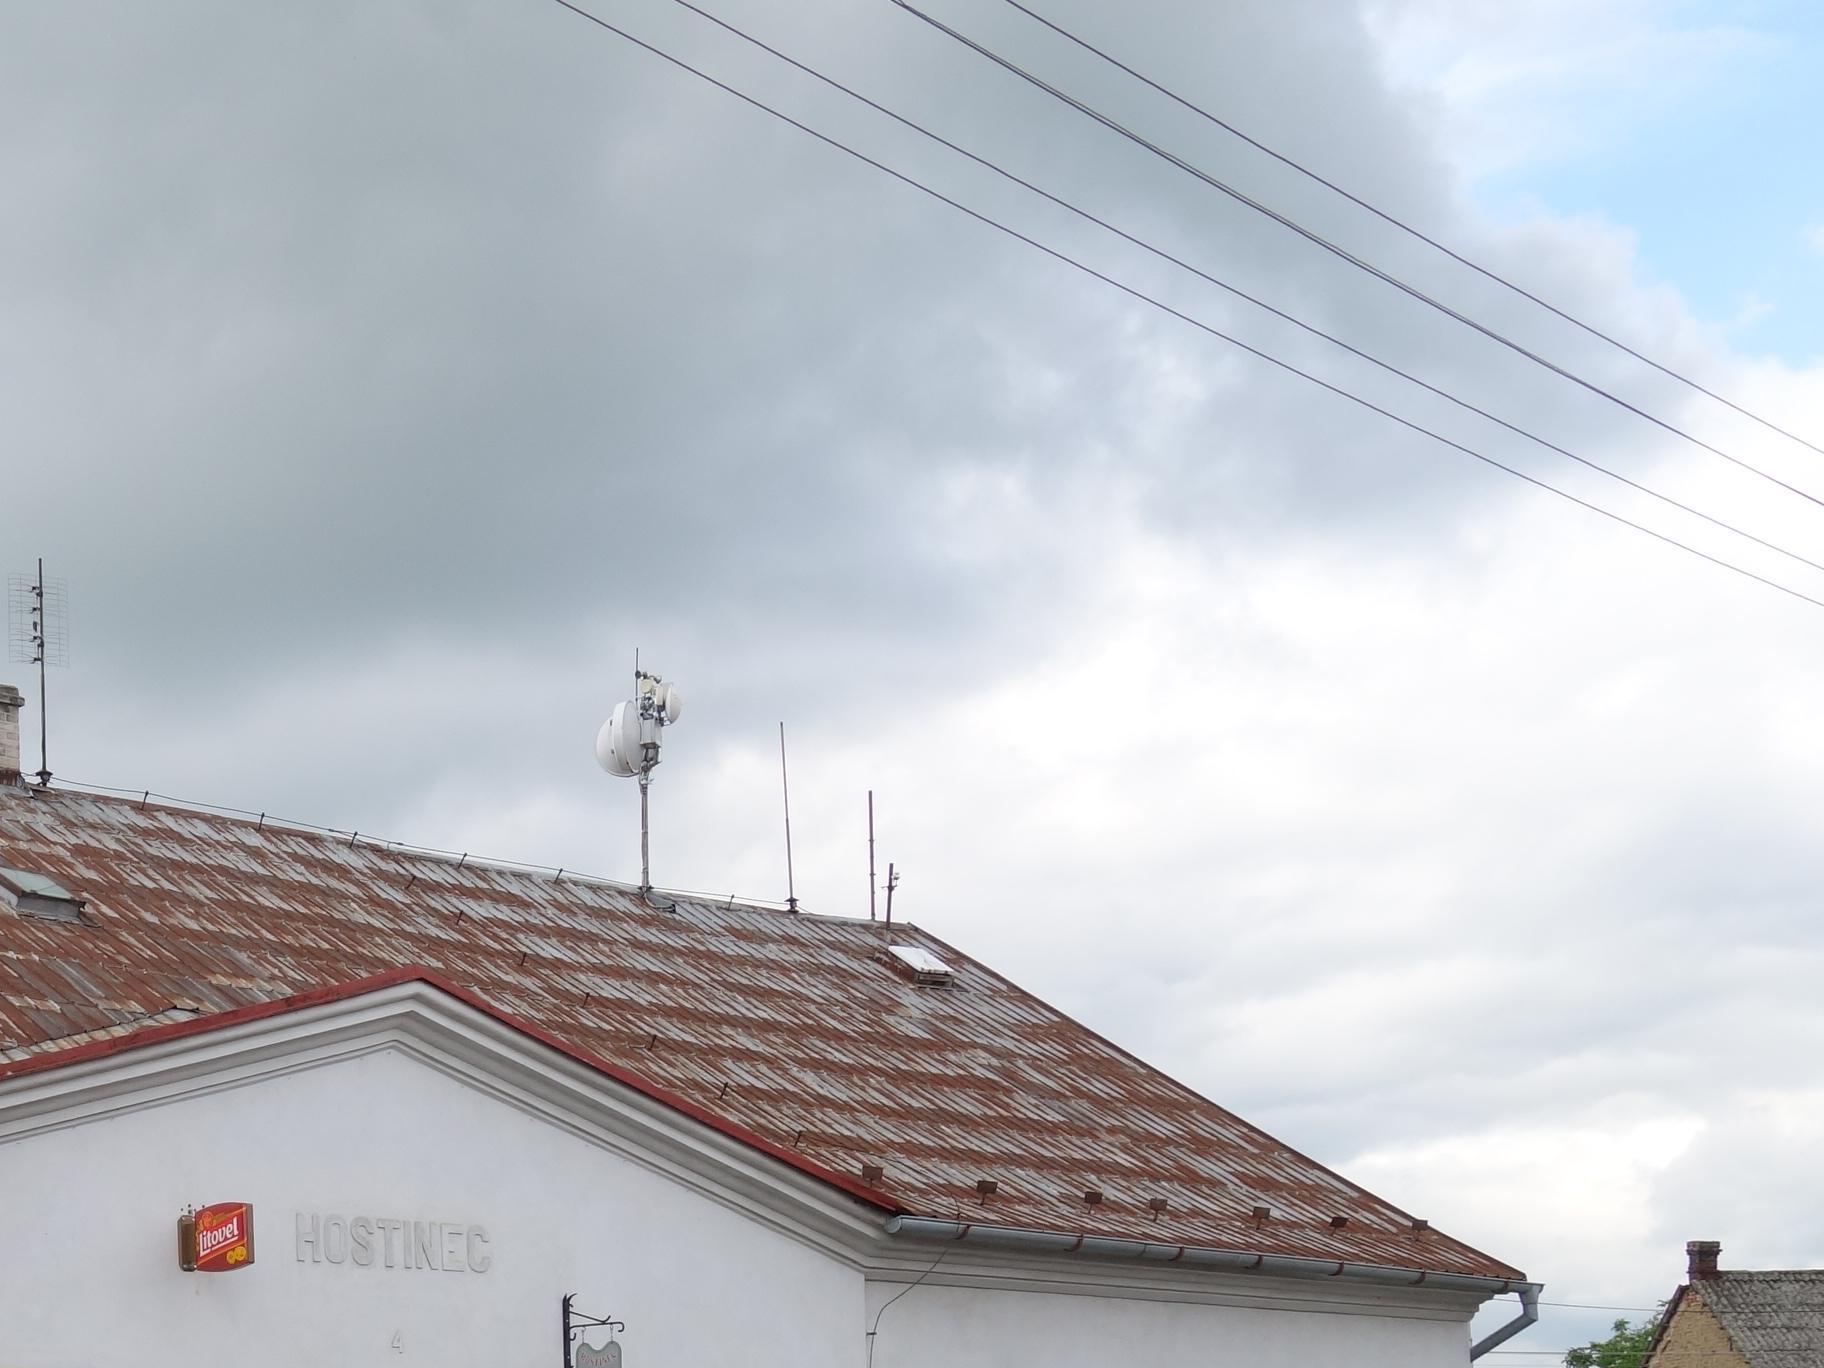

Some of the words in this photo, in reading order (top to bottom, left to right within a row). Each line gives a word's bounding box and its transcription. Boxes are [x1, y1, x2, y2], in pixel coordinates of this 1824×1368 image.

[198, 1217, 239, 1256] Litovel
[295, 1211, 491, 1274] HOSTINEC
[391, 1329, 404, 1355] 4
